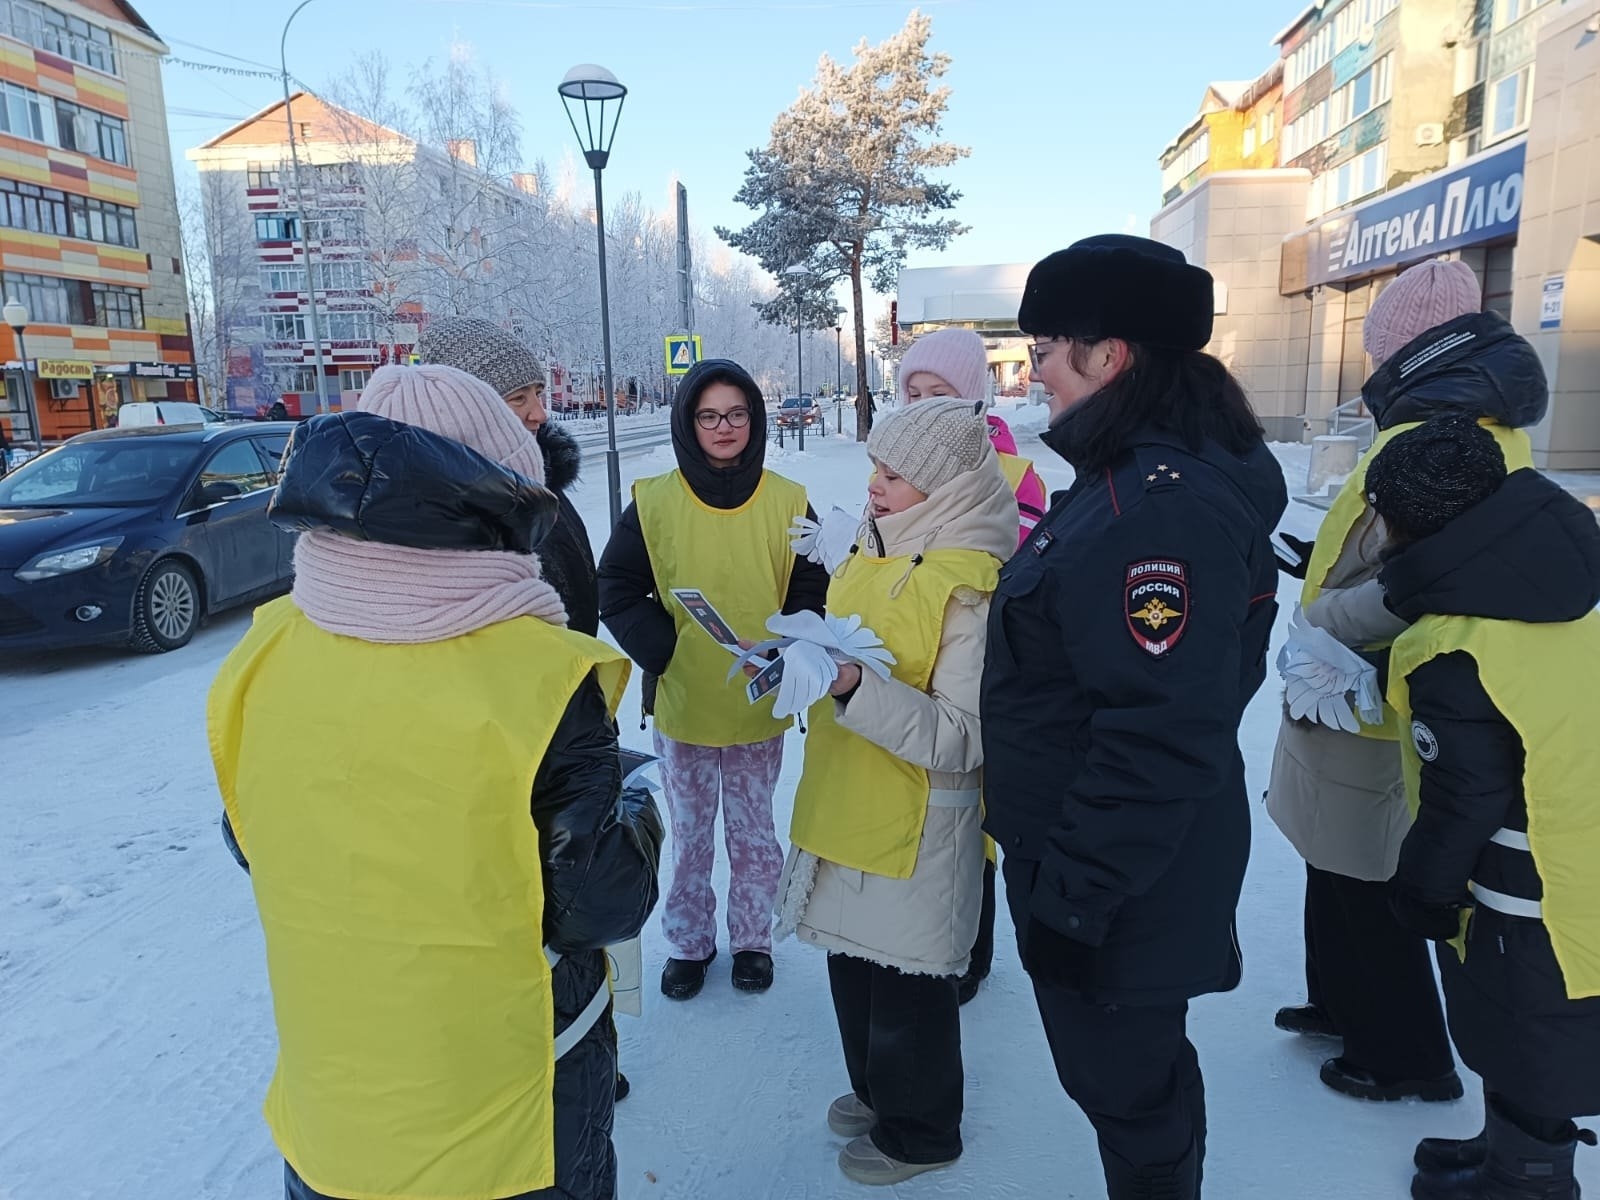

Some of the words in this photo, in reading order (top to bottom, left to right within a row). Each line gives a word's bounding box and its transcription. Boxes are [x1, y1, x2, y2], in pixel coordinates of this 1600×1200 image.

[1342, 203, 1436, 269] Аптека
[41, 361, 91, 376] Радость
[1130, 563, 1181, 578] ПОЛИЦИЯ
[1132, 583, 1180, 600] РОССИЯ
[1145, 640, 1168, 655] МВД
